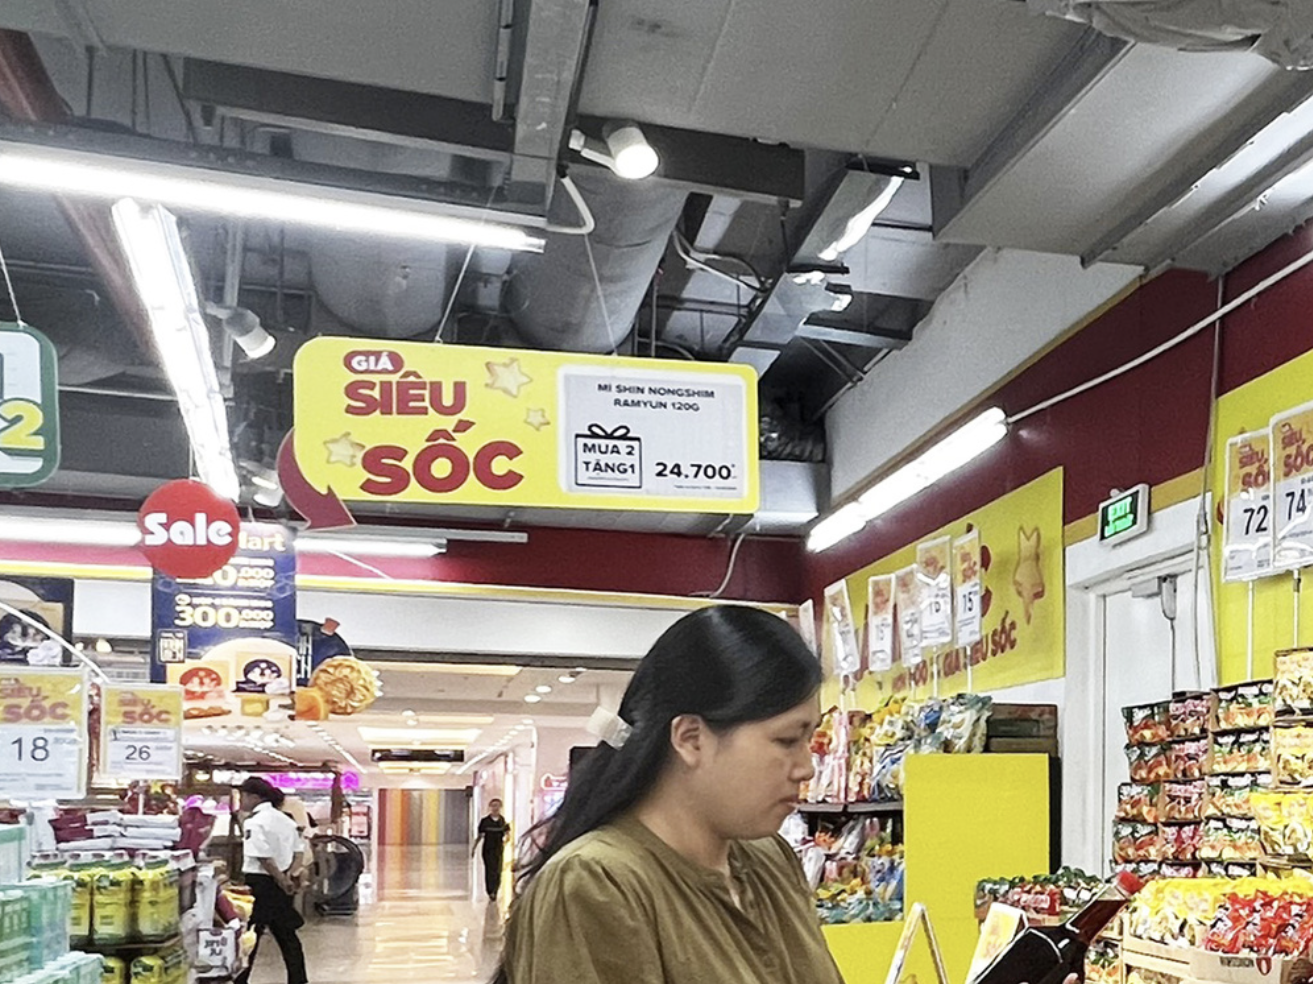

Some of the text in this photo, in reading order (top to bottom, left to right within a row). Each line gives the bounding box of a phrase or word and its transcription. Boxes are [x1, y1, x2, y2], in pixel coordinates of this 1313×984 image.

[351, 351, 393, 372] GIÁ
[343, 371, 467, 416] SIÊU
[613, 398, 668, 410] RAMYUN
[615, 385, 645, 395] SHIN
[648, 387, 716, 398] NONGSHIM
[359, 420, 524, 496] SỐC
[583, 442, 635, 456] MUA 2
[1285, 489, 1306, 521] 74
[144, 512, 233, 546] Sale
[1243, 505, 1269, 535] 72
[238, 530, 286, 552] art
[991, 610, 1017, 657] SỐC
[11, 736, 50, 762] 18
[124, 745, 151, 761] 26
